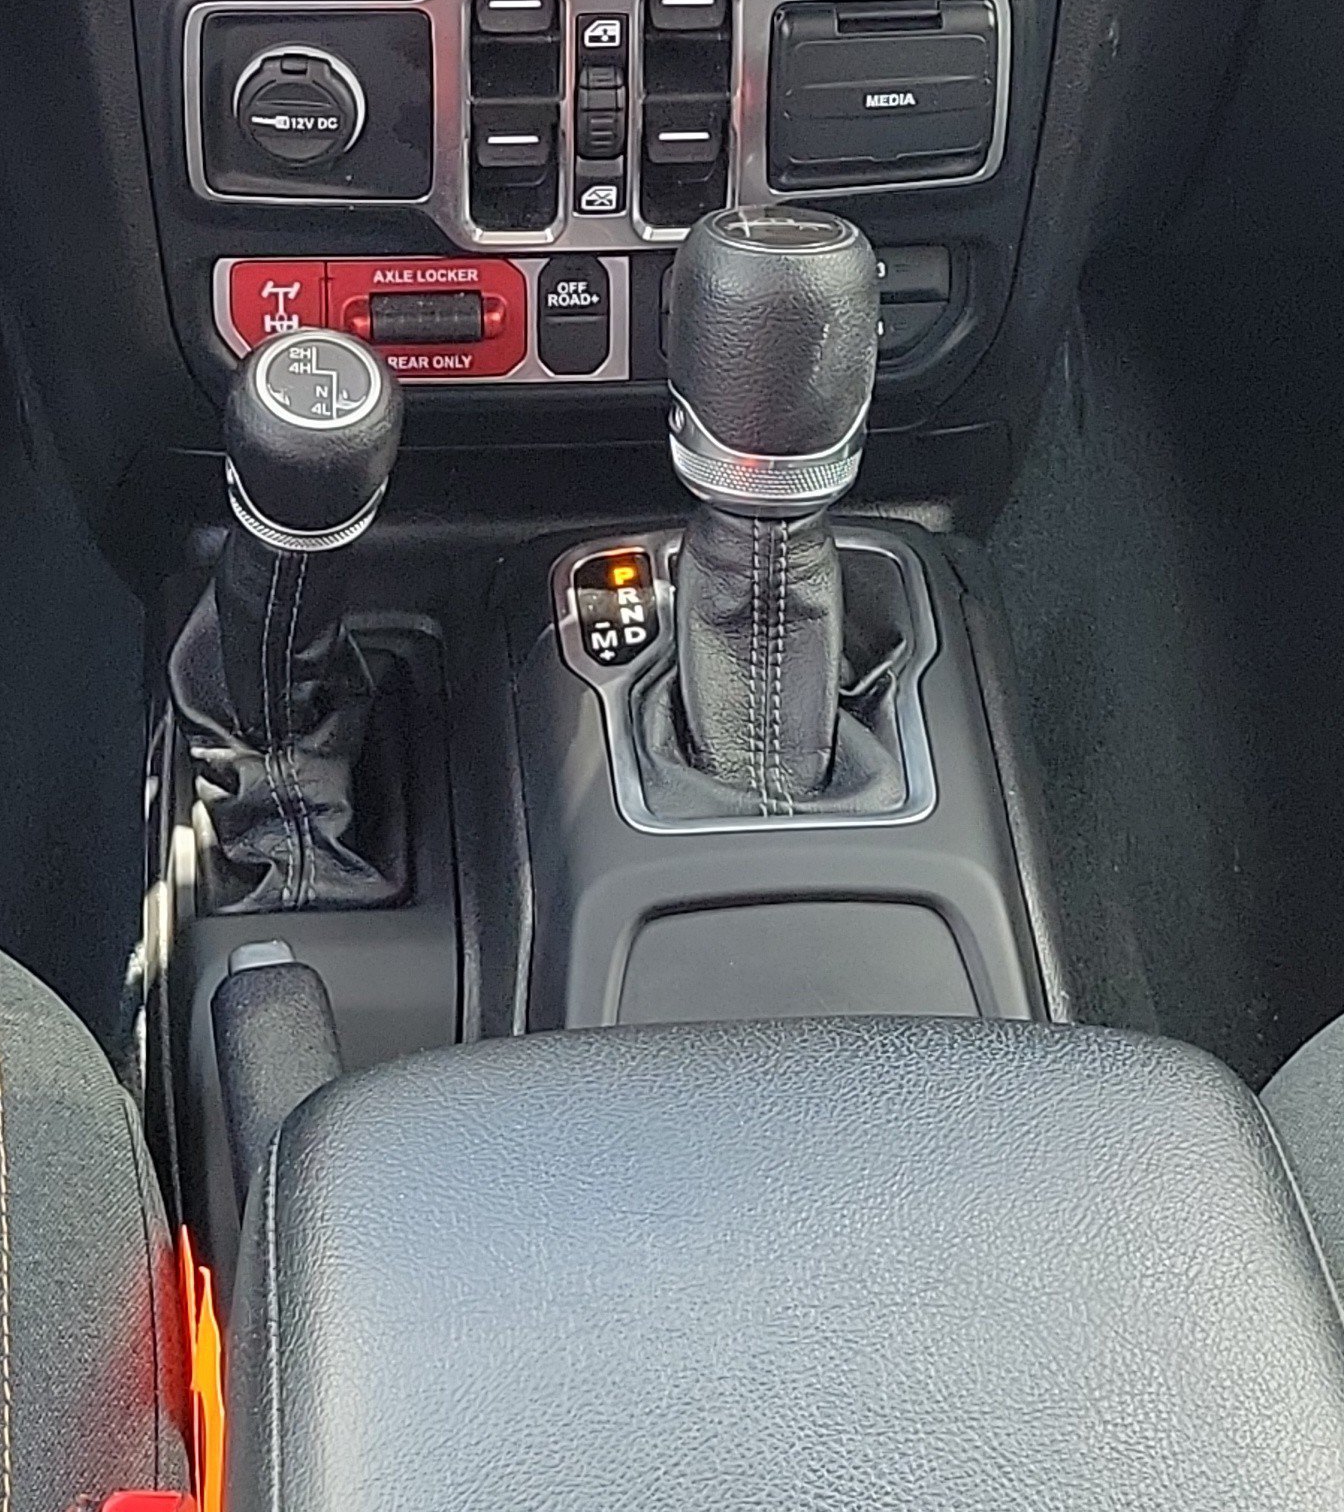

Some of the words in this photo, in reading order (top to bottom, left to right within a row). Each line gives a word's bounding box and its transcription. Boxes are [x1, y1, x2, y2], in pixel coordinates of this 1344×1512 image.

[866, 93, 916, 108] MEDIA
[291, 117, 315, 129] 12V
[318, 117, 338, 129] DC
[373, 271, 414, 283] AXLE
[417, 269, 479, 283] LOCKER
[557, 283, 587, 294] OFF
[289, 347, 311, 359] 2H
[289, 362, 311, 374] 4H
[388, 356, 429, 369] REAR
[432, 355, 472, 369] ONLY
[316, 386, 328, 398] N
[311, 403, 331, 416] 4L
[614, 567, 634, 585] P
[618, 588, 640, 605] R
[620, 605, 645, 624] N
[591, 630, 618, 650] M
[624, 627, 647, 644] D
